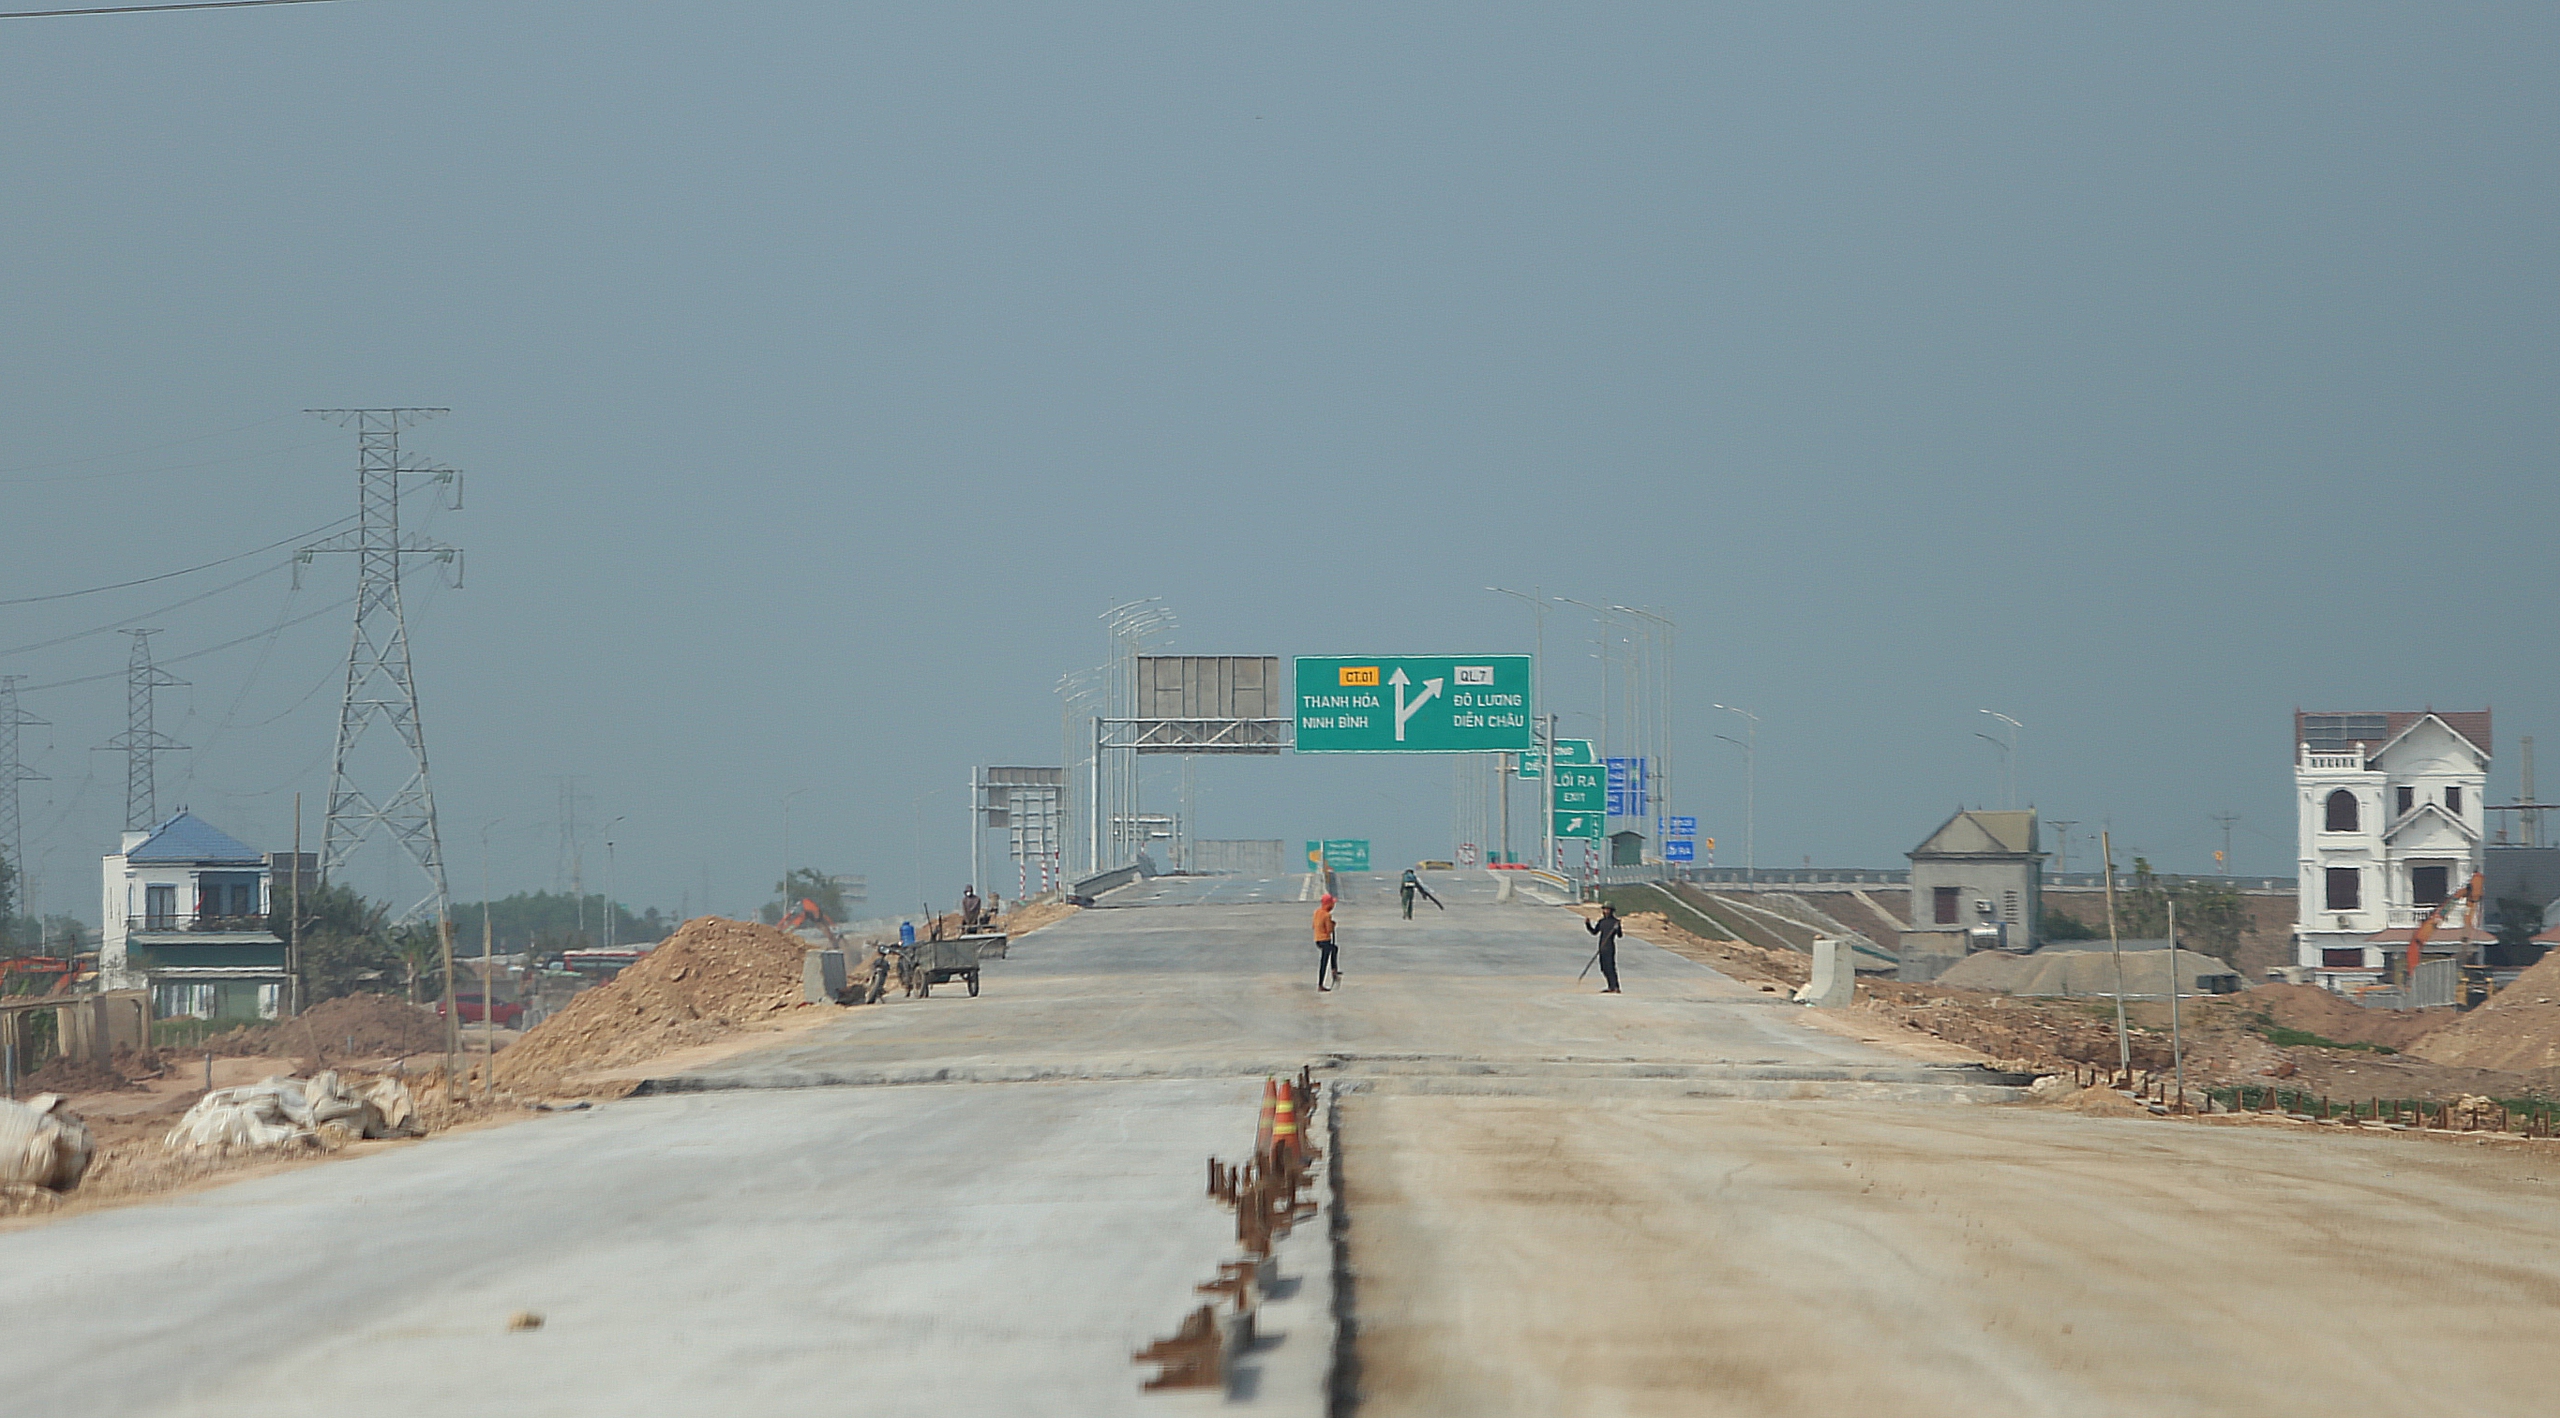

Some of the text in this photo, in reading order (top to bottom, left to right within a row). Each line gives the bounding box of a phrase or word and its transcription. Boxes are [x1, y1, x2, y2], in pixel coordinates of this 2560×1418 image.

[1346, 671, 1373, 682] CT.01
[1460, 670, 1487, 682] QL.7
[1303, 692, 1380, 708] THANH HÓA
[1453, 692, 1473, 707] ĐÔ
[1303, 713, 1369, 729] NINH BÌNH
[1488, 712, 1524, 728] CHÂU
[1577, 774, 1597, 788] RA
